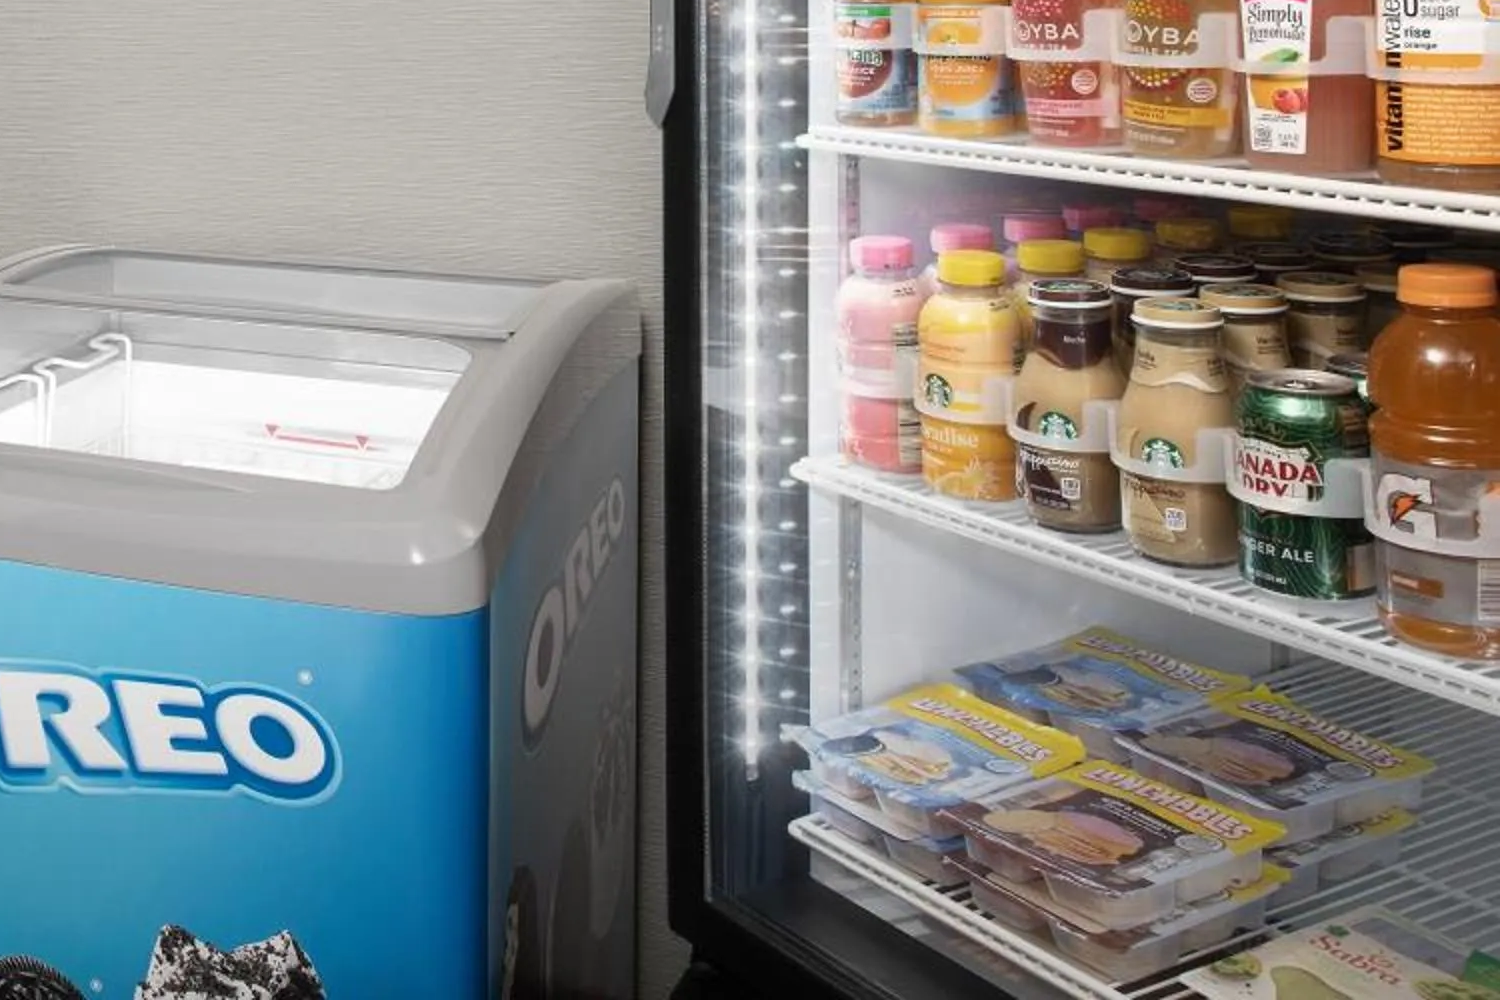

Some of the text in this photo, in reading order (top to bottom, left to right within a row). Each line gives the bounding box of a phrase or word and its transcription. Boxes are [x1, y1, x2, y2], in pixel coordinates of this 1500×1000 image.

[1247, 2, 1303, 34] Simply
[1420, 5, 1461, 21] sugar
[1404, 25, 1431, 39] rise
[1235, 452, 1323, 485] ANADA
[1280, 545, 1315, 564] ALE
[523, 478, 624, 727] OREO
[1309, 933, 1403, 986] Sabra
